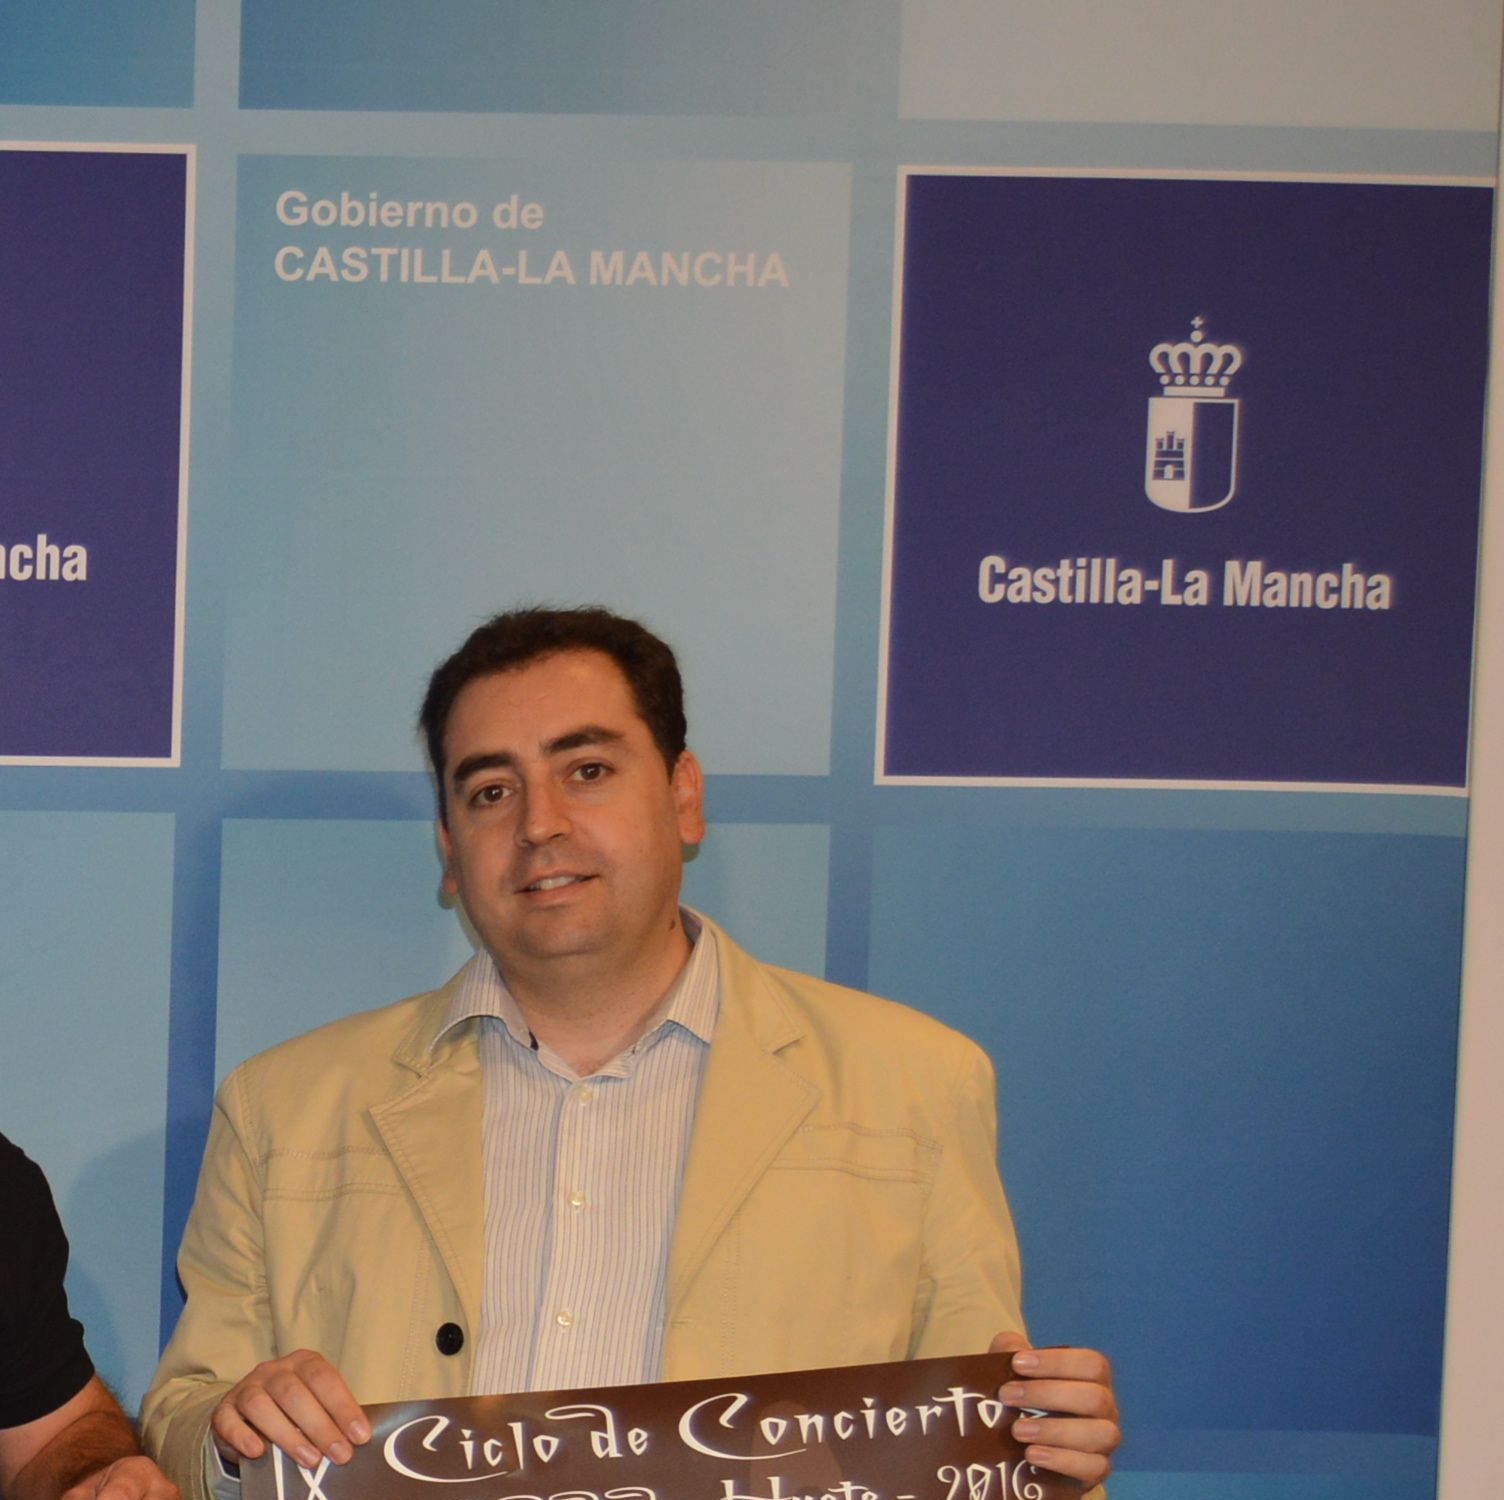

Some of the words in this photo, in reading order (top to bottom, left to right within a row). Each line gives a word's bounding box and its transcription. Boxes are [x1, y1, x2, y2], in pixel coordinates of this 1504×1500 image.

[275, 191, 478, 228] Gobierno
[492, 195, 545, 229] de
[274, 246, 576, 285] CASTILLA-LA
[589, 250, 790, 288] MANCHA
[978, 555, 1208, 606] Castilla-La
[1223, 560, 1391, 610] Mancha
[384, 1414, 560, 1483] Ciclo
[545, 1404, 650, 1460] de
[678, 1386, 1048, 1461] Concierto
